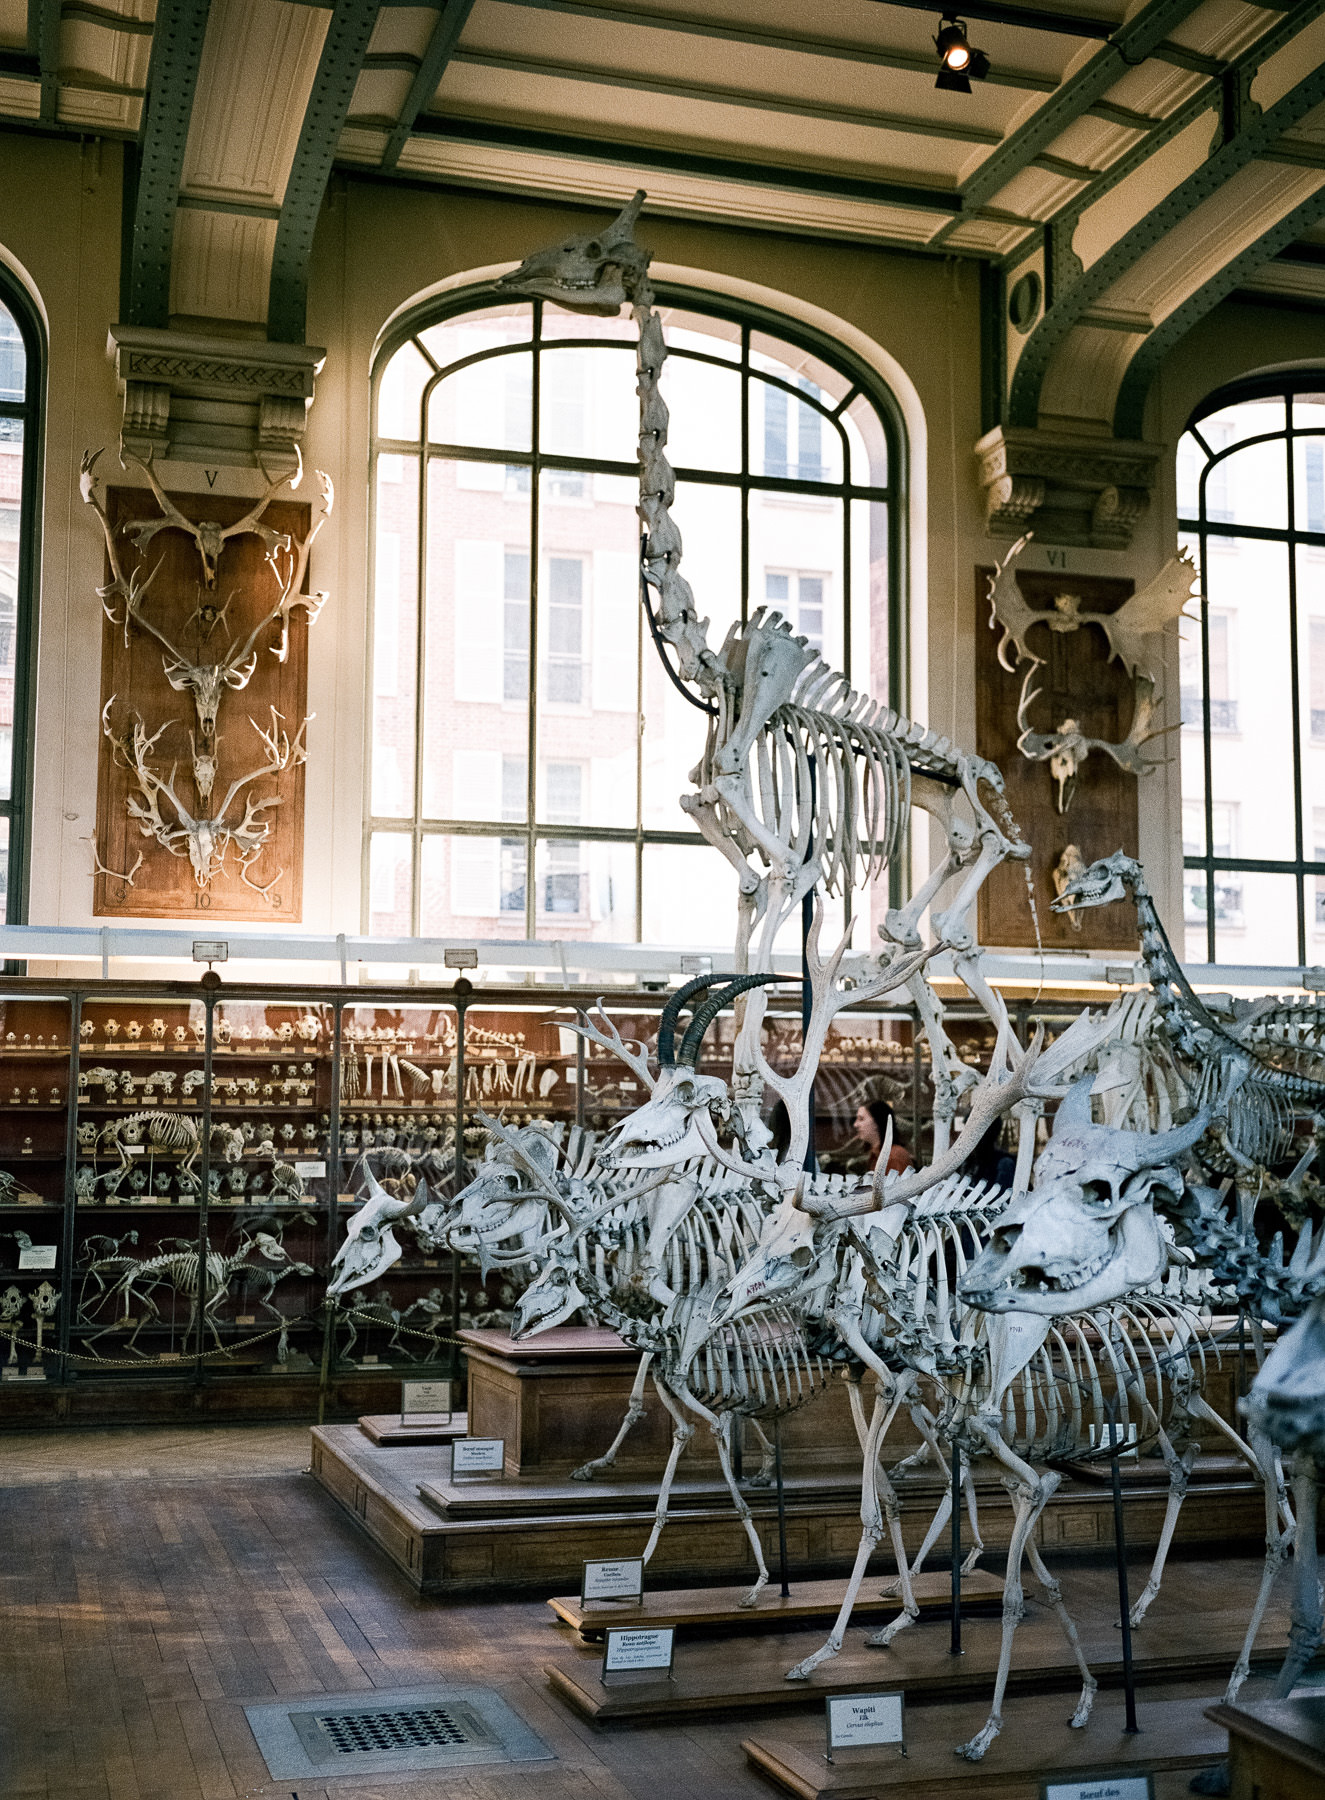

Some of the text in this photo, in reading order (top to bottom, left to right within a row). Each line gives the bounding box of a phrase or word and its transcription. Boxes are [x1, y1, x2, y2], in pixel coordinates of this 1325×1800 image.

[204, 470, 219, 489] V
[1046, 550, 1067, 569] VI
[194, 892, 211, 909] 10
[620, 1634, 659, 1642] Hippotrague
[851, 1705, 876, 1715] Wapiti
[1104, 1787, 1120, 1797] des
